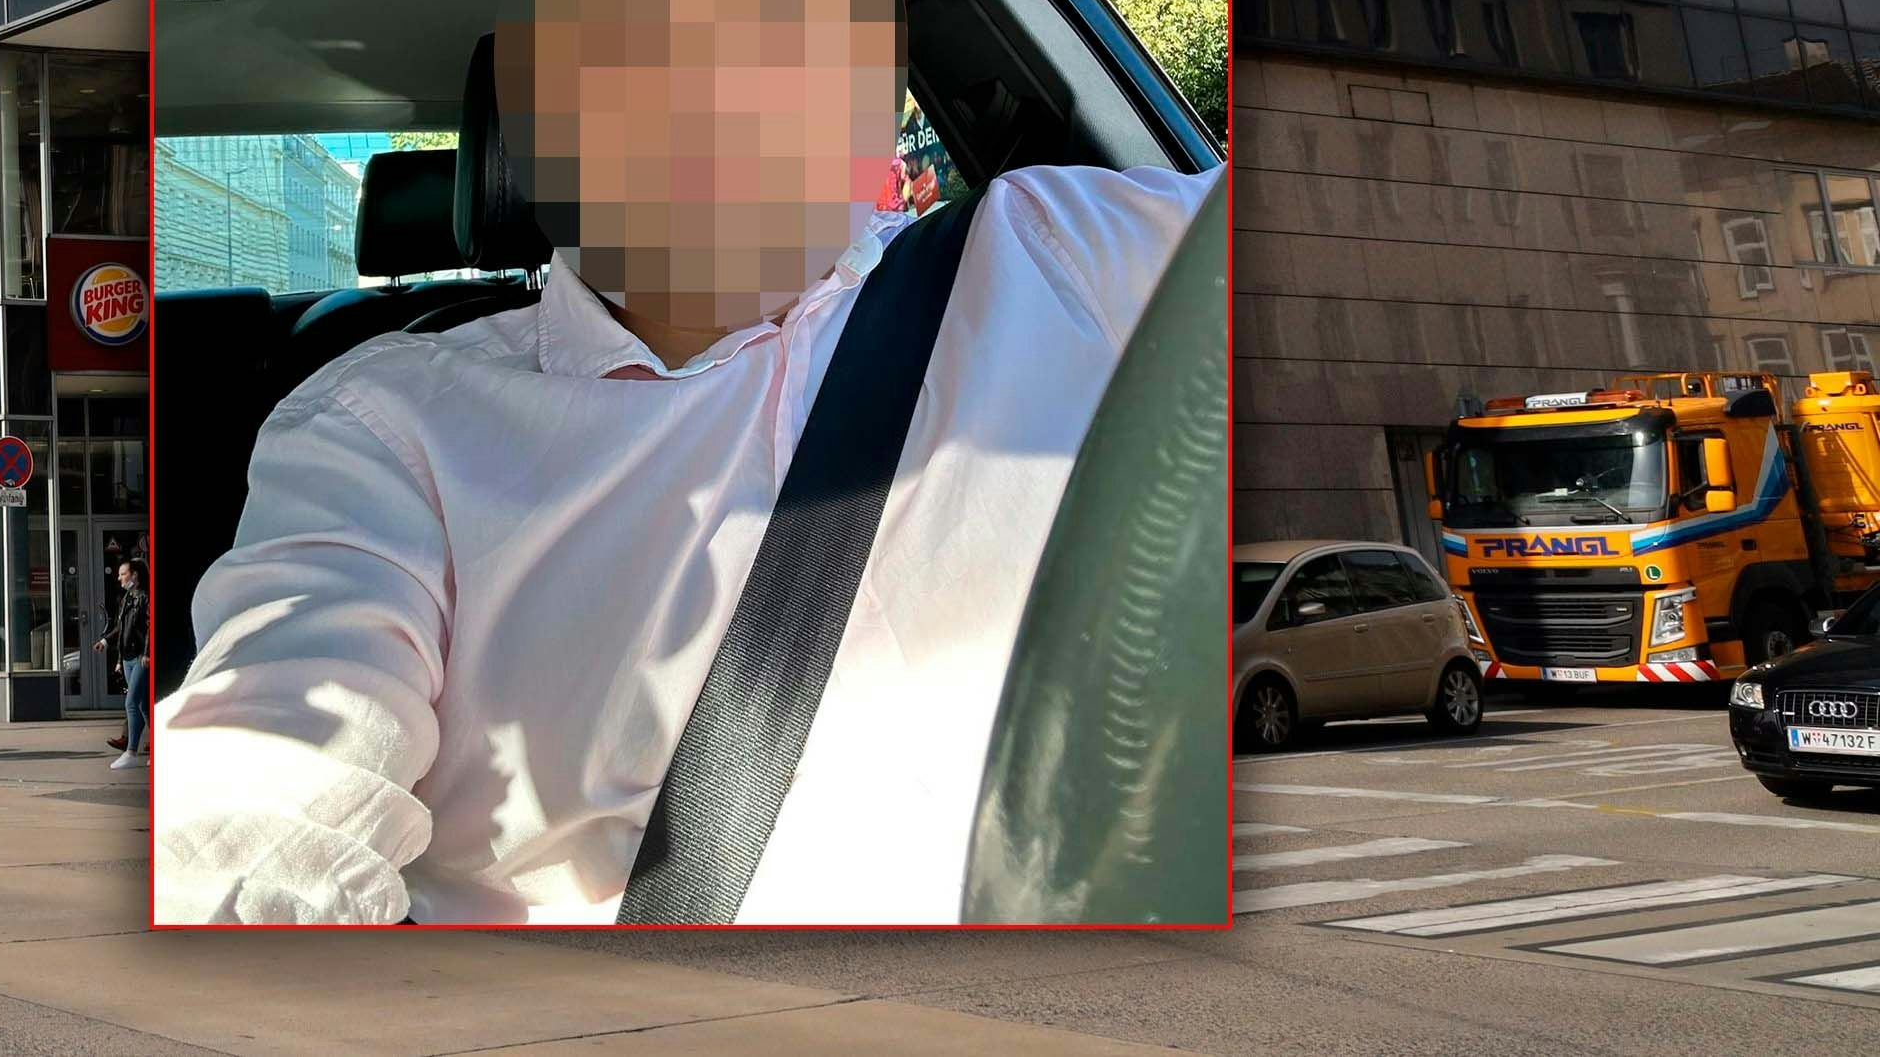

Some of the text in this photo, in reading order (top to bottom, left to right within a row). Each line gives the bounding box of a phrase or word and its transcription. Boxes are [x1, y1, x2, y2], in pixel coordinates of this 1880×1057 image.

[84, 279, 142, 305] BURGER
[86, 293, 144, 326] KING
[1531, 397, 1583, 407] PRANGL
[1474, 534, 1620, 558] PRANGL
[1802, 731, 1811, 744] W
[1822, 733, 1865, 749] 47132
